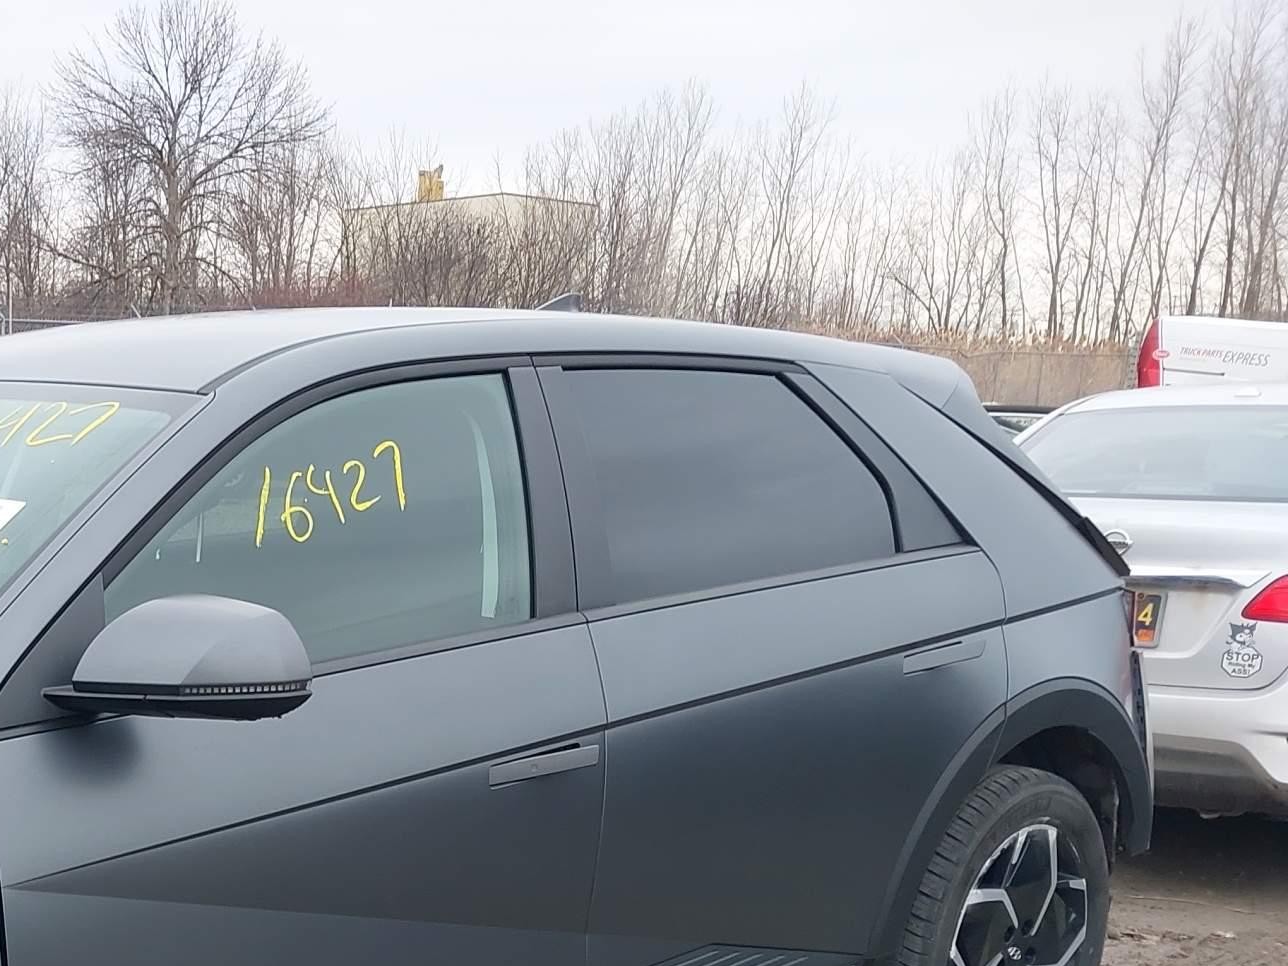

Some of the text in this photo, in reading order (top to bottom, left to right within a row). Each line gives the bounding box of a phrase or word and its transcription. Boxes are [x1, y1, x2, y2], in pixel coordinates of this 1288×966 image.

[1180, 347, 1271, 367] TRUCK PARTS EXPRESS
[255, 440, 406, 548] 16427
[1137, 603, 1155, 626] 4
[1225, 650, 1259, 663] STOP
